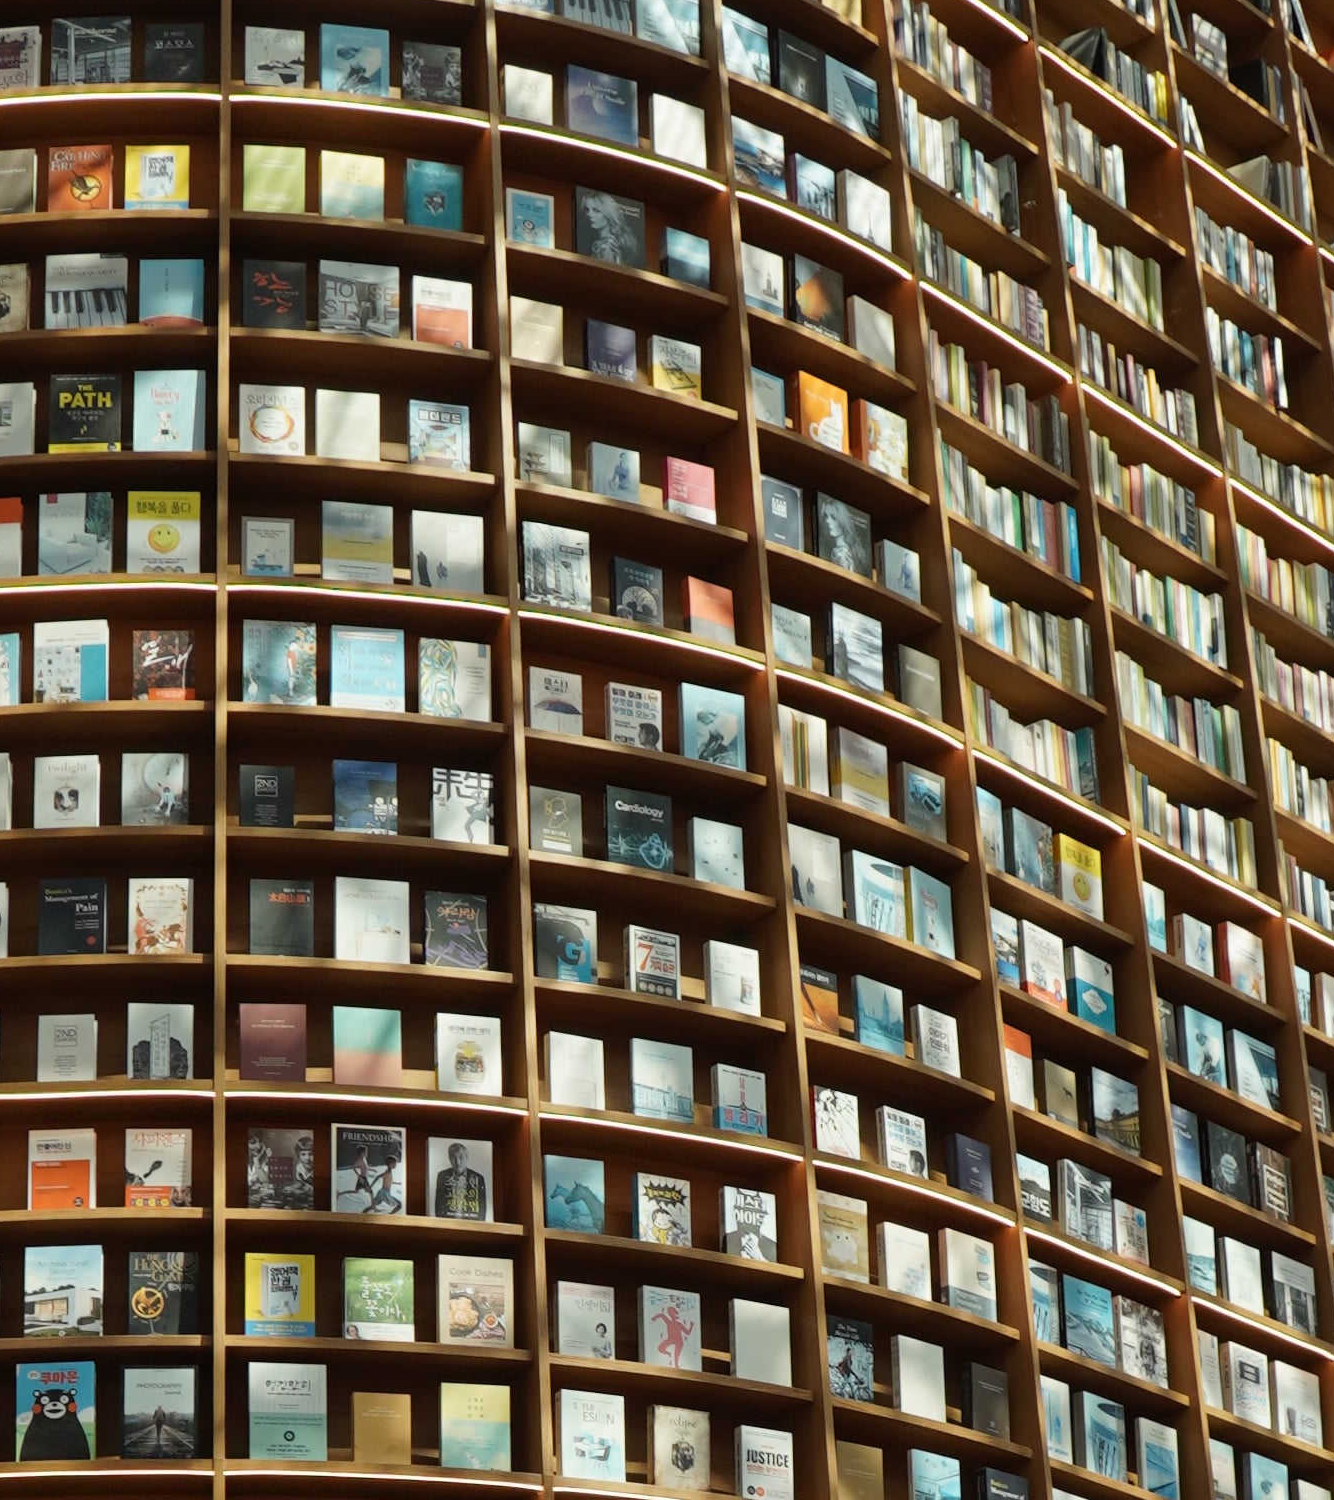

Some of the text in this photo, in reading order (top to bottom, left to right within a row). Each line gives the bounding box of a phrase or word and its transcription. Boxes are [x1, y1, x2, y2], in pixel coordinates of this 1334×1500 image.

[54, 151, 106, 161] CATCHING
[51, 161, 72, 171] FIRE
[326, 279, 399, 300] HOUSE
[327, 300, 399, 317] STYLE
[78, 384, 92, 392] THE
[59, 391, 111, 409] PATH
[137, 500, 191, 514] 행복을 풀다
[48, 764, 87, 774] twilight
[615, 800, 664, 818] Cardiology
[46, 894, 86, 902] Management
[75, 903, 98, 912] Pain
[343, 1131, 400, 1142] FRIENDSHIP
[450, 1268, 503, 1278] Cook Dishes
[39, 1368, 77, 1384] 쿠마몬
[747, 1449, 789, 1468] JUSTICE
